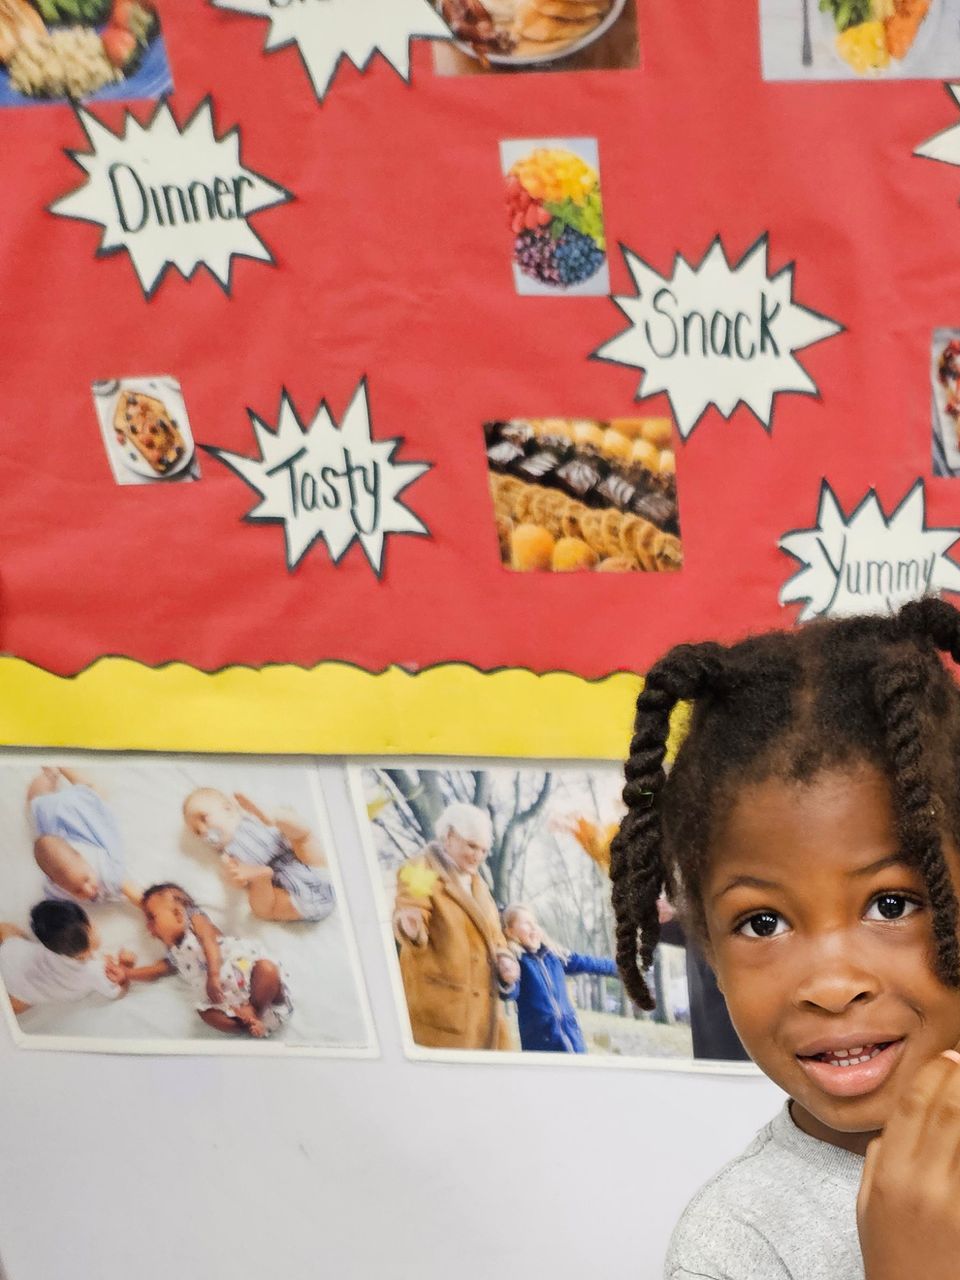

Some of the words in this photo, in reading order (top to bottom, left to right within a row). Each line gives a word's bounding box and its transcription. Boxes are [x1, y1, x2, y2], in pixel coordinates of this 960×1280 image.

[108, 162, 254, 233] Dinner
[645, 288, 780, 360] Snack
[265, 446, 379, 535] Tasty
[816, 533, 936, 616] Yummy
